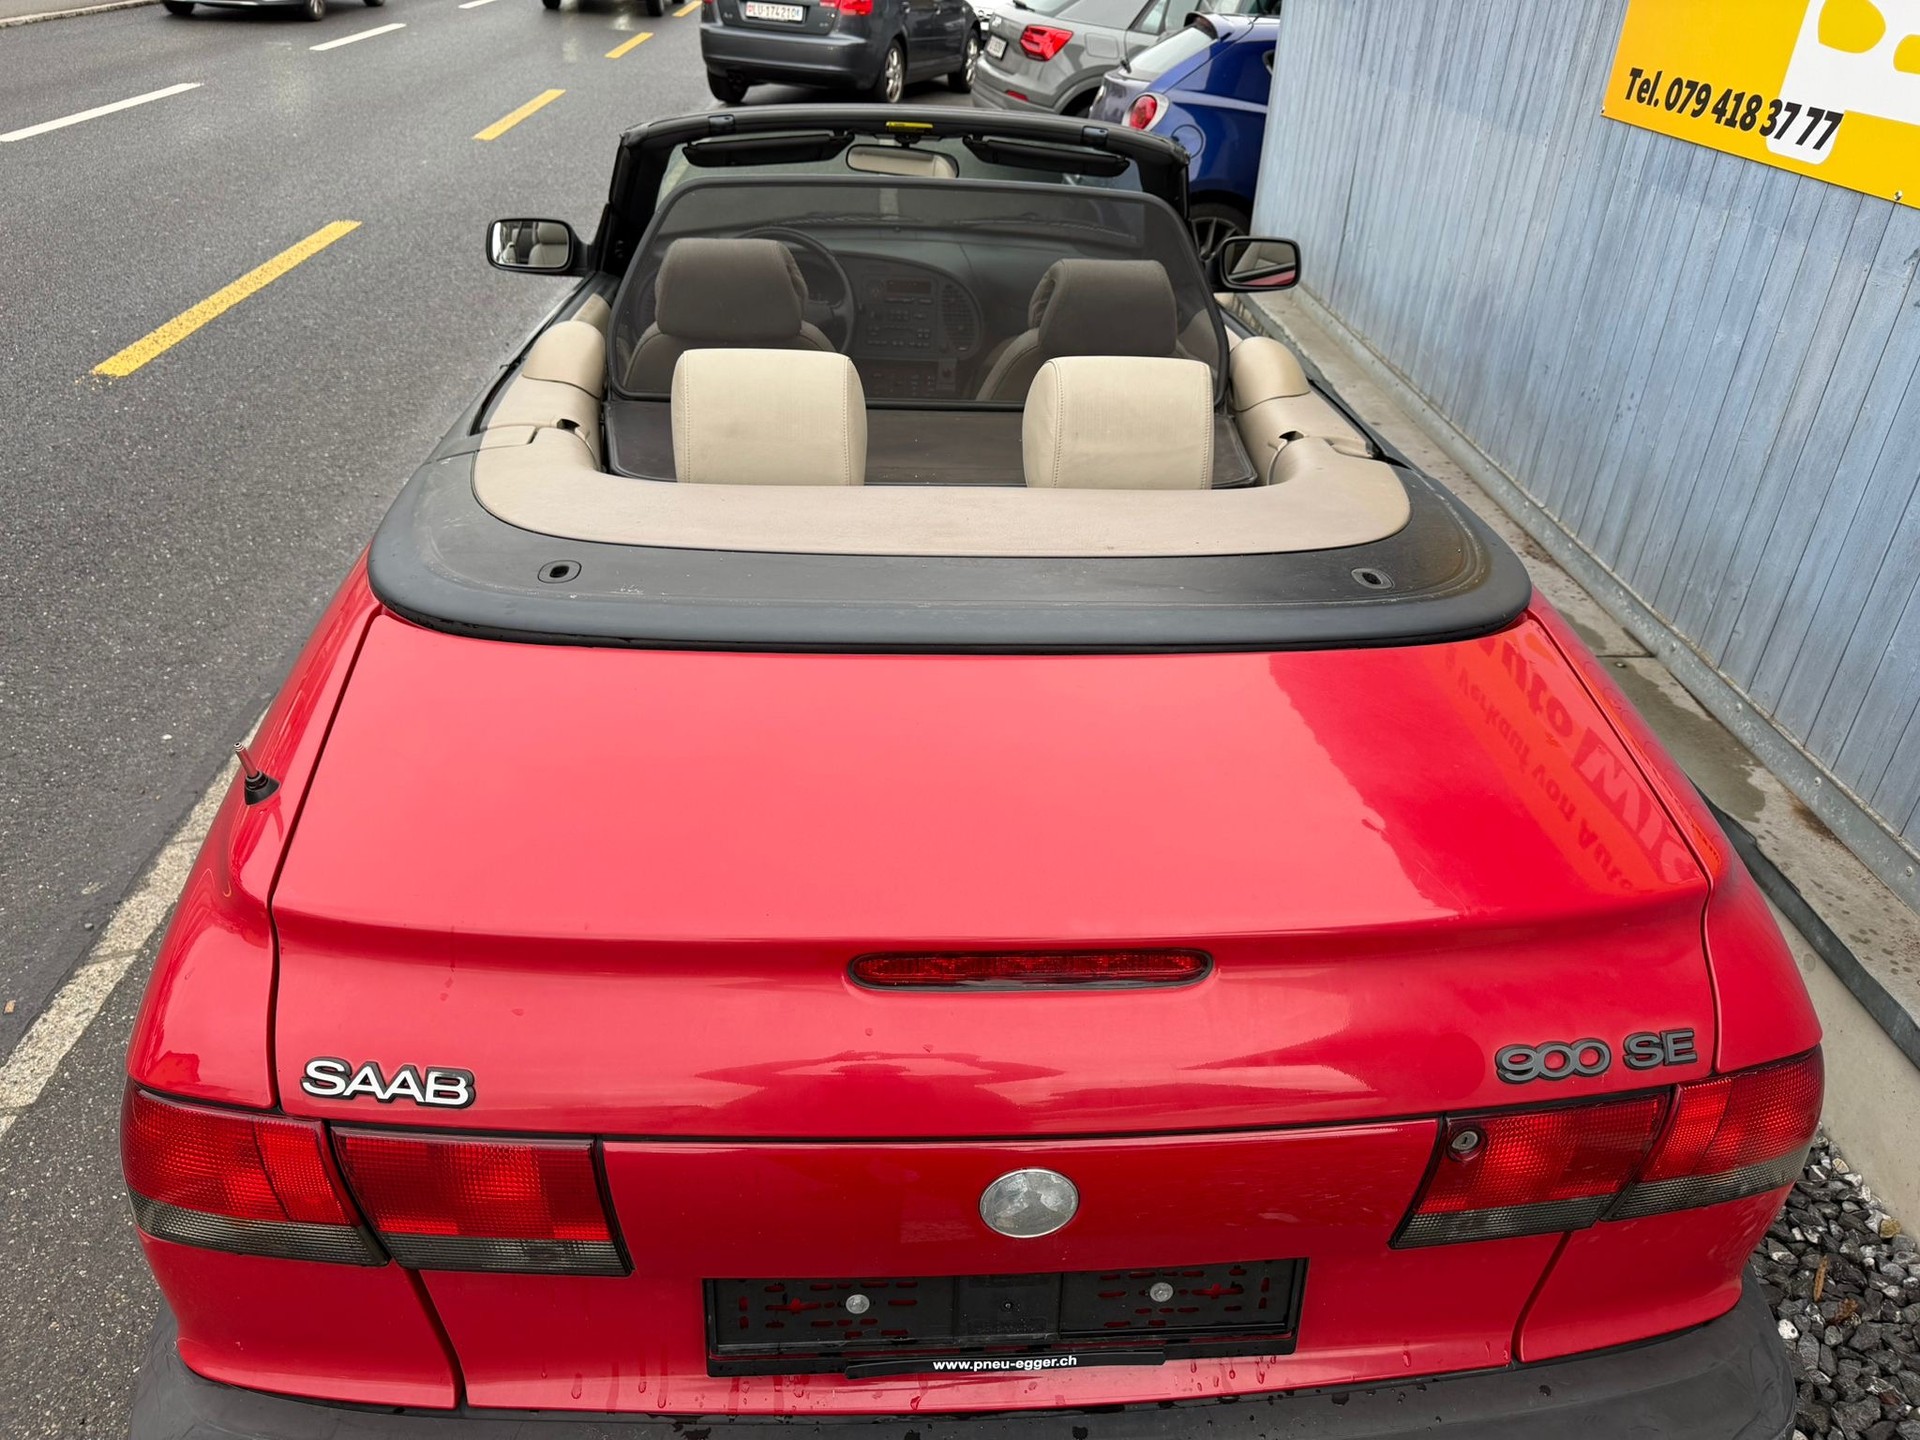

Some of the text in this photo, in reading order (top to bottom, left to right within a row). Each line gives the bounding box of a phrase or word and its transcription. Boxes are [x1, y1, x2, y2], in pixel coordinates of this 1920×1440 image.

[1624, 67, 1844, 150] Tel. 079 418 37 77
[302, 1056, 476, 1108] SAAB
[1495, 1028, 1698, 1084] 900 SE
[932, 1355, 1077, 1372] www.pneu-egger.ch
